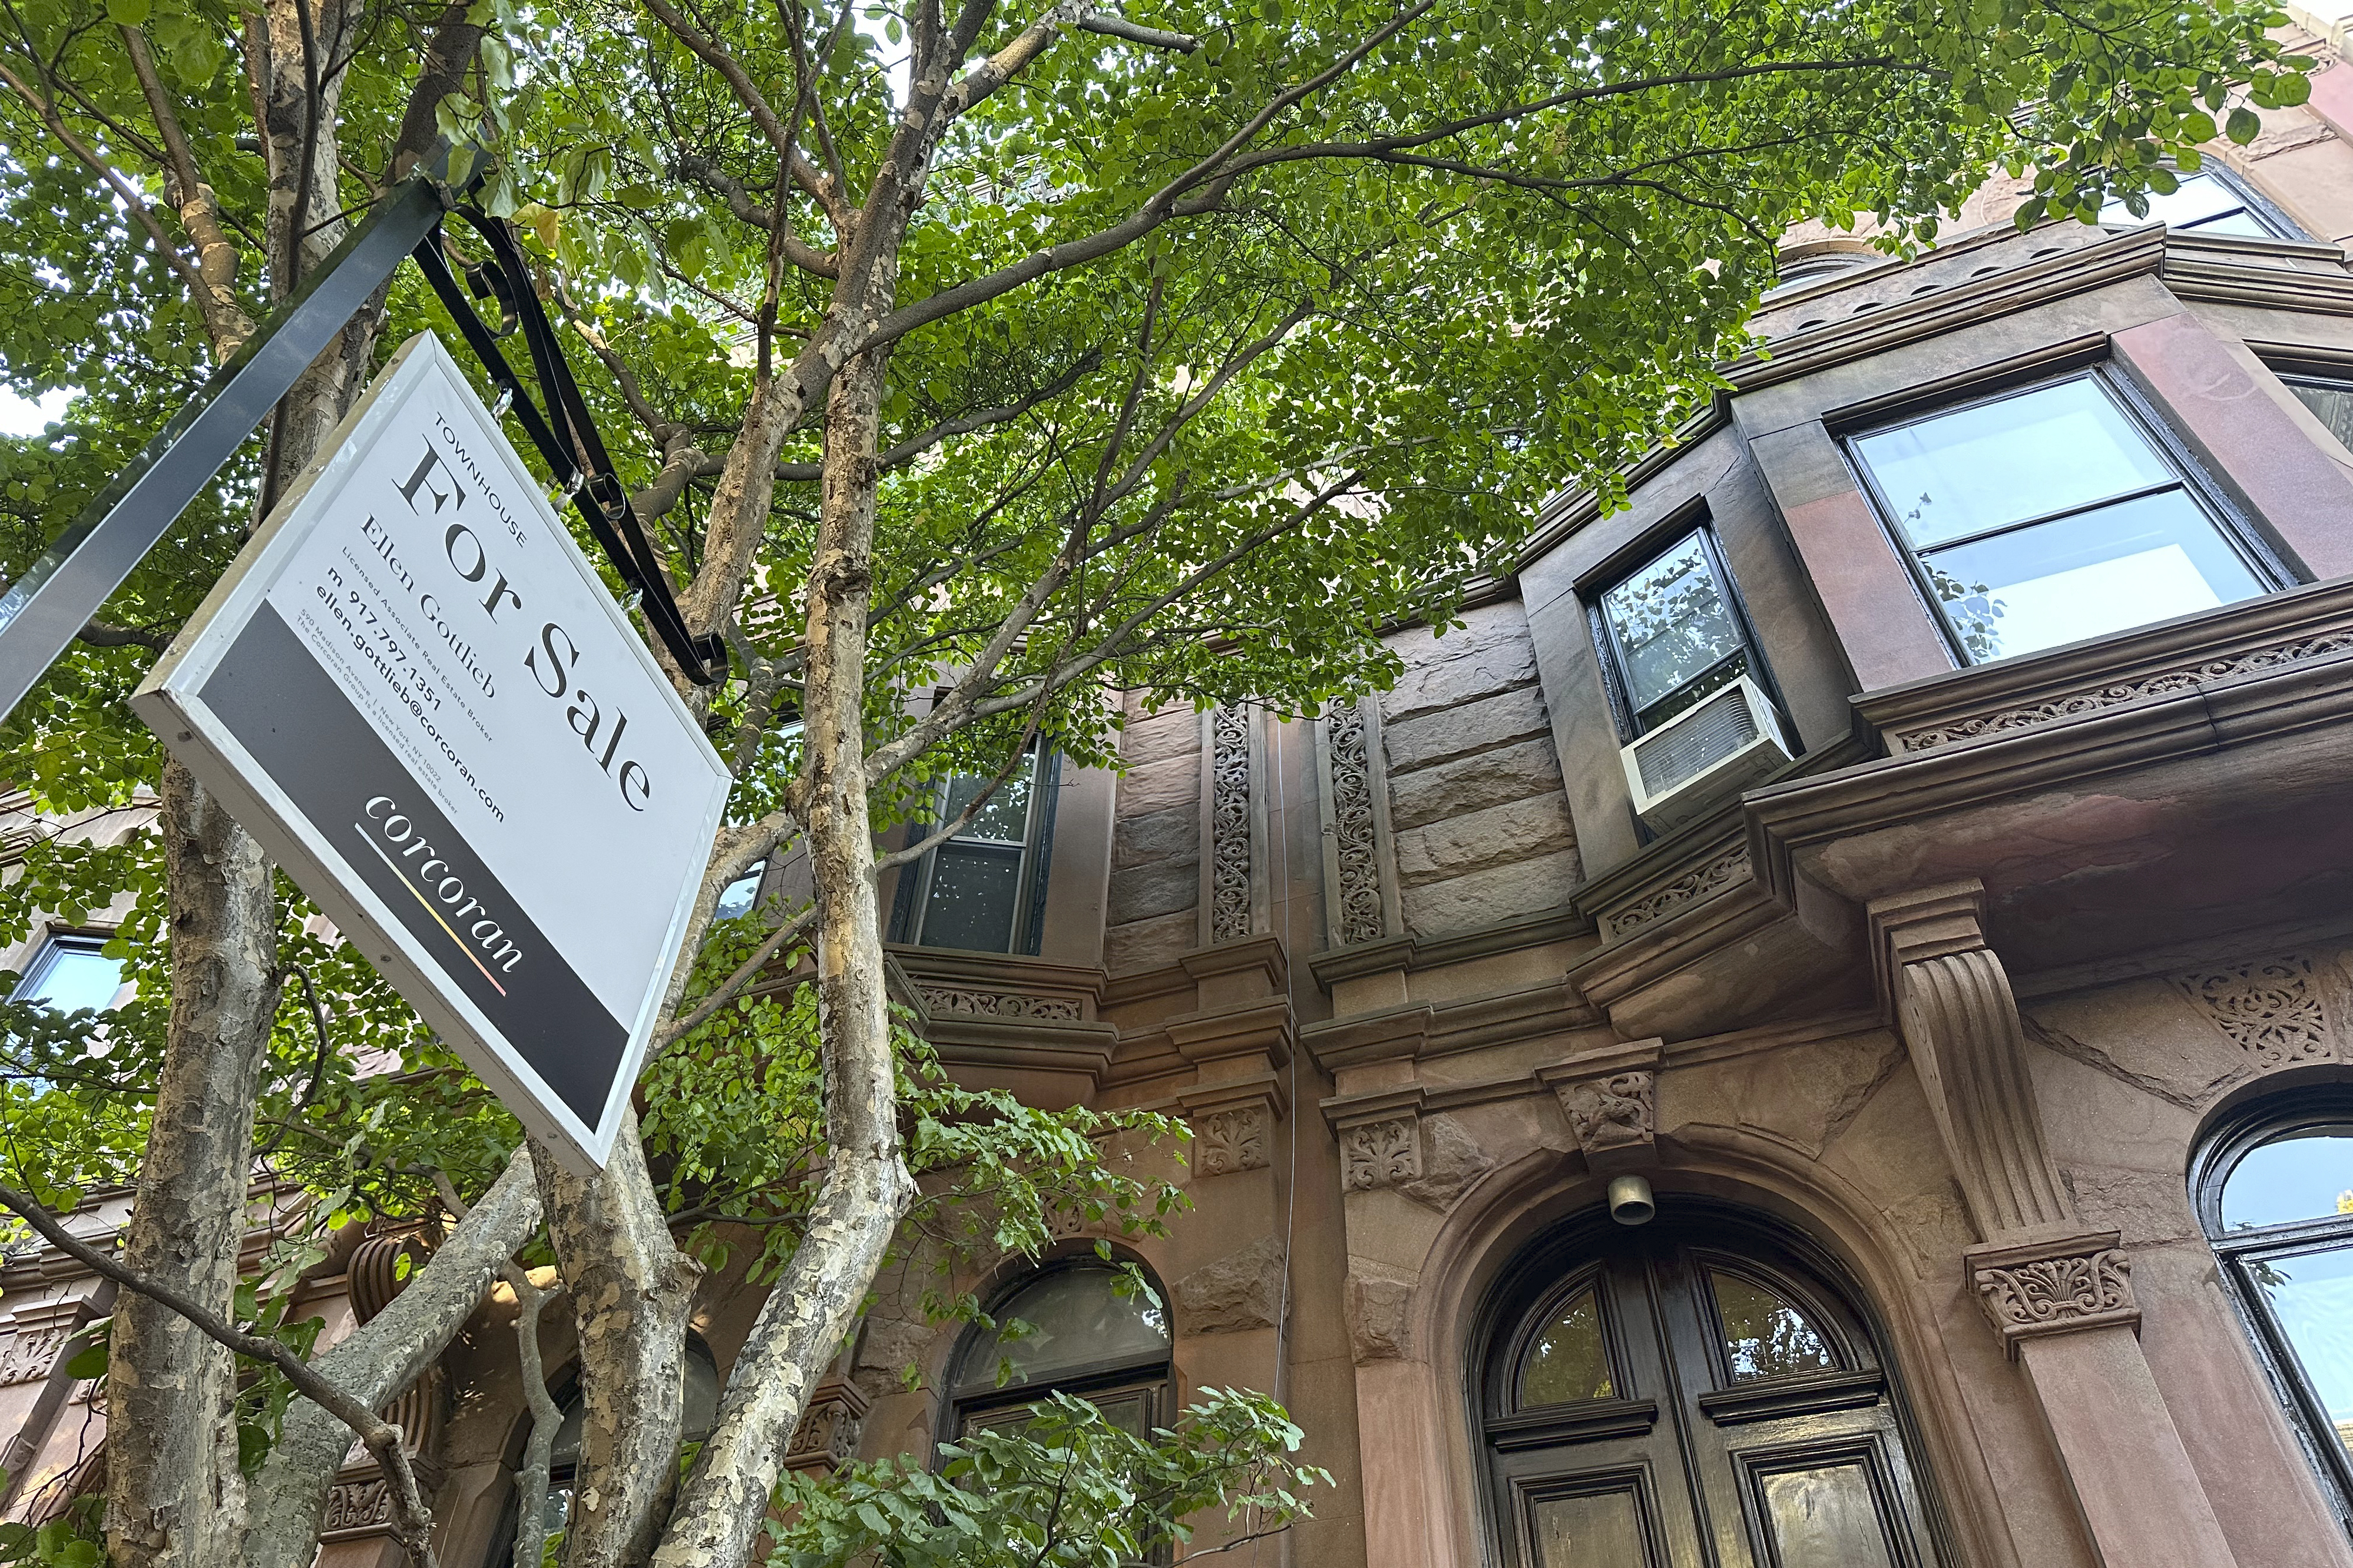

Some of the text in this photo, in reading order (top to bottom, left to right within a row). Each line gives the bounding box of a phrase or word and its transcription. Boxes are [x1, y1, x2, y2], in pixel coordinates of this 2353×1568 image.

[435, 411, 527, 549] TOWNHOUSE
[300, 608, 315, 626] 590
[315, 626, 345, 665] Madison
[345, 665, 370, 697] Avenue
[380, 706, 395, 725] New
[412, 745, 423, 758] NY
[423, 758, 441, 783] 10022
[327, 566, 441, 711] m 917.797.1351
[342, 546, 492, 742] Licensed Associate Real Estate Broker
[360, 513, 495, 698] Ellen Gottlieb
[391, 433, 650, 812] For Sale
[297, 615, 310, 634] The
[311, 633, 342, 673] Corcoran
[343, 673, 364, 700] Group
[378, 715, 405, 750] licensed
[405, 750, 418, 765] real
[418, 766, 437, 790] estate
[438, 788, 458, 814] broker
[317, 586, 504, 823] ellen.gottlieb@corcoran.com
[365, 796, 522, 973] corcoran
